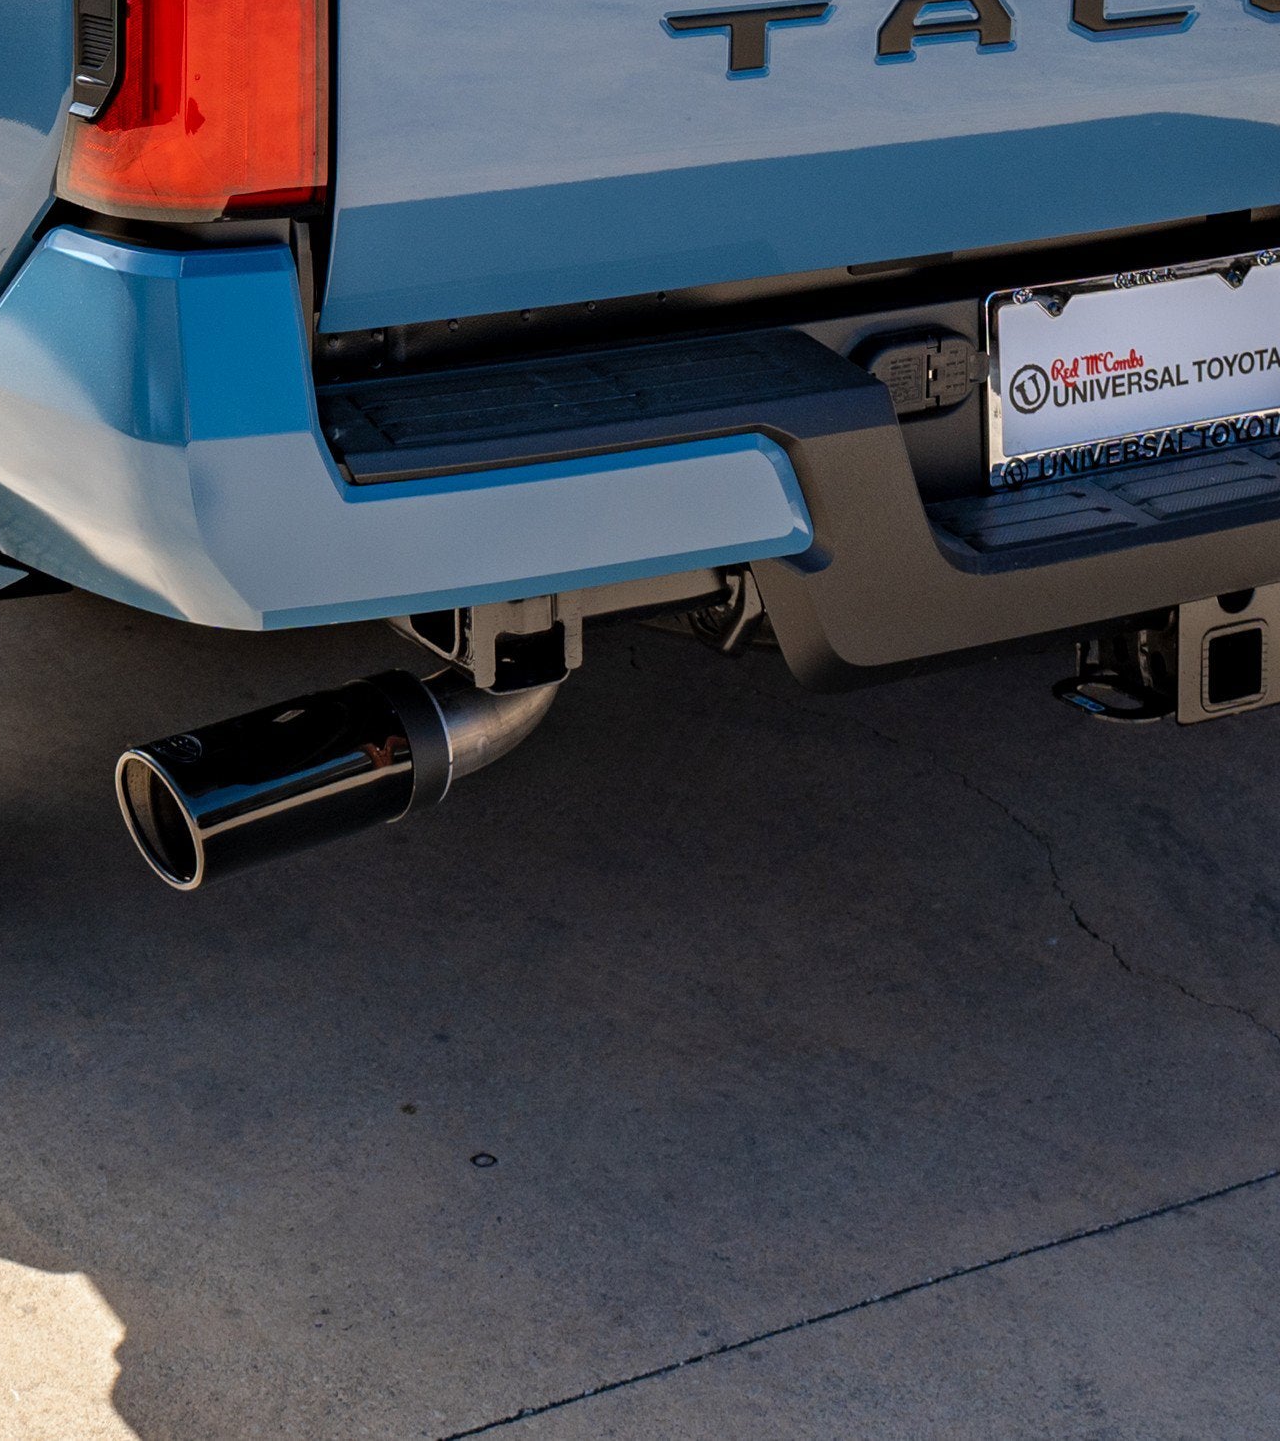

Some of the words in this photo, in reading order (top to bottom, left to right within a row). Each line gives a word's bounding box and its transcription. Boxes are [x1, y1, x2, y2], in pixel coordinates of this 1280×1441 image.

[1051, 358, 1080, 388] Red
[1080, 348, 1144, 376] McCombs
[1052, 364, 1189, 408] UNIVERSAL
[1037, 428, 1191, 480] UNIVERSAL
